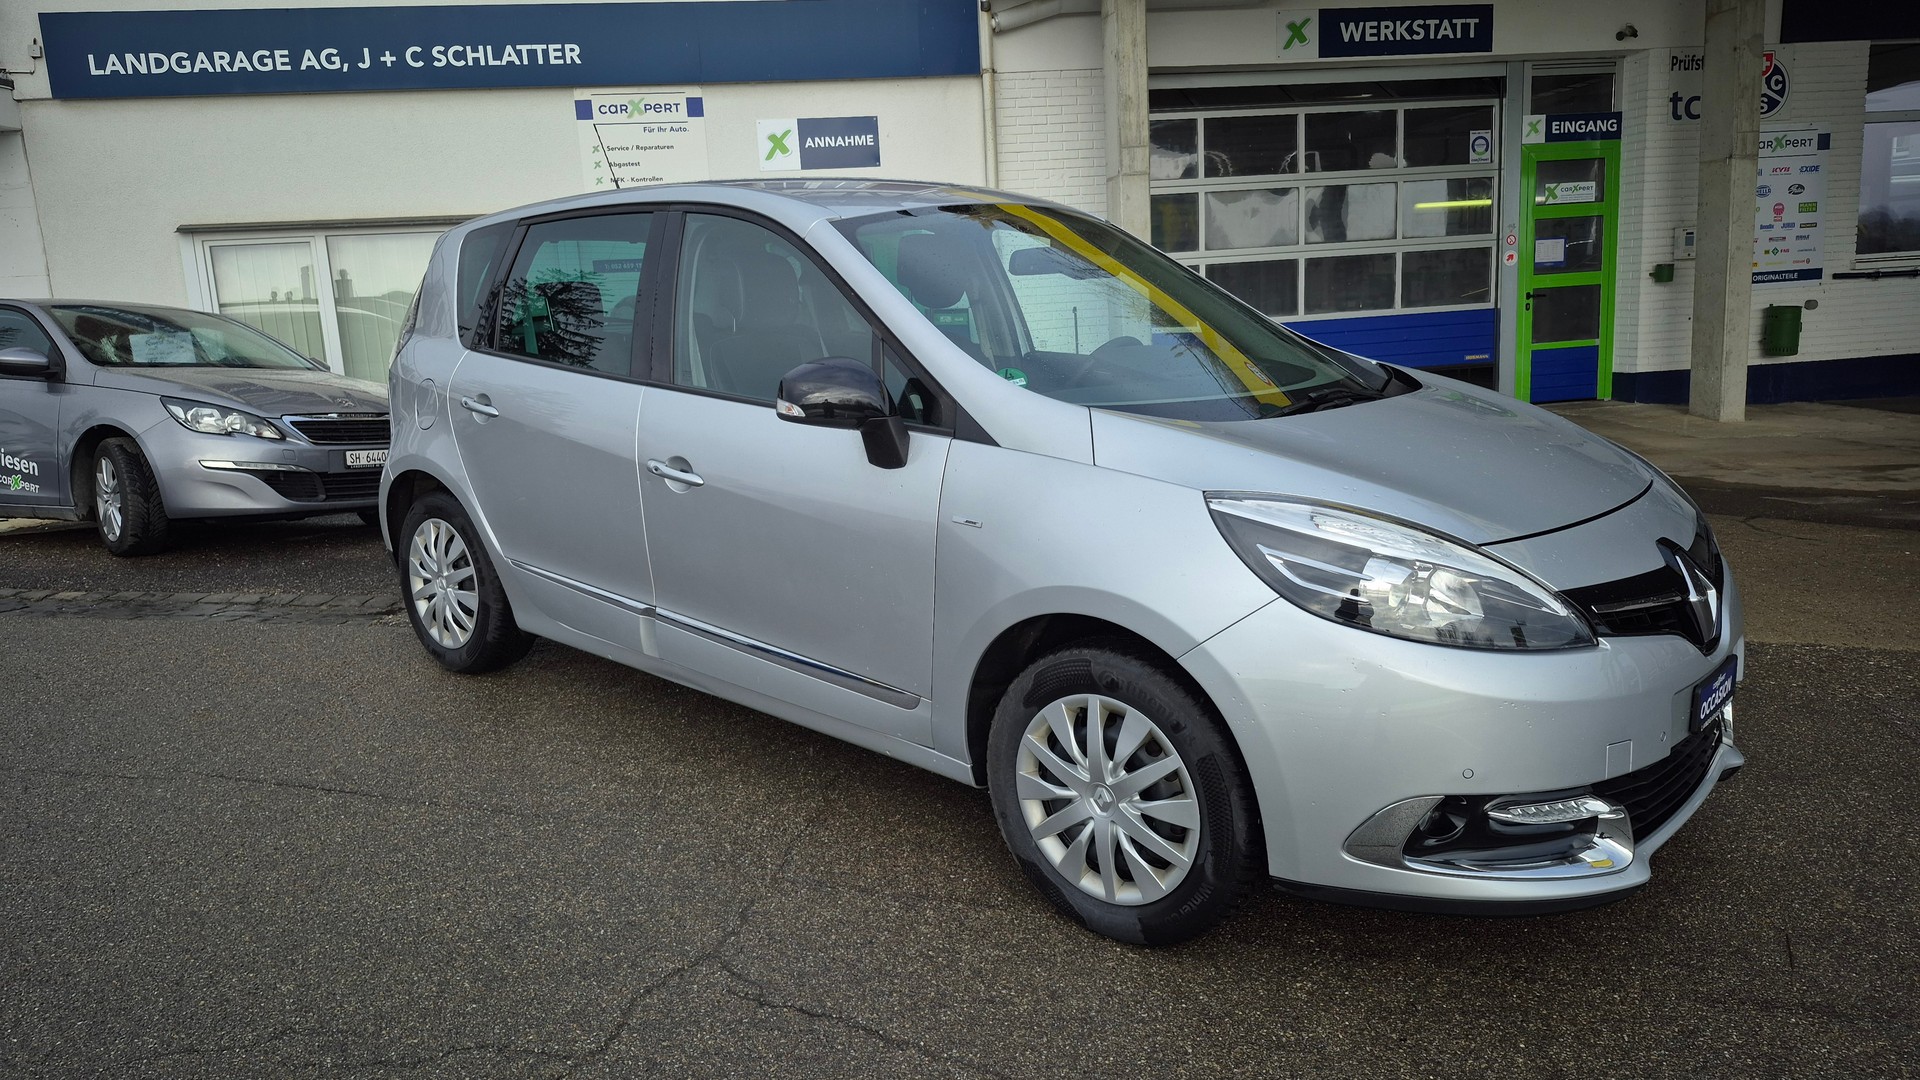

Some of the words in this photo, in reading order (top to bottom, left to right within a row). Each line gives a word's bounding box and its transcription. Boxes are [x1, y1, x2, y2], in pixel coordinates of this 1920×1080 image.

[1340, 18, 1479, 42] WERKSTATT
[88, 49, 291, 76] LANDGARAGE
[301, 49, 348, 72] AG,
[358, 51, 370, 70] J
[380, 52, 393, 67] +
[406, 46, 425, 68] C
[432, 44, 581, 67] SCHLATTER
[669, 125, 690, 133] Auto.
[1552, 119, 1618, 134] EINGANG
[636, 144, 675, 153] Reparaturen
[805, 134, 875, 149] ANNAHME
[609, 161, 641, 169] Abgastest
[1752, 272, 1798, 282] ORIGINALTEILE
[0, 448, 39, 476] iesen
[349, 452, 361, 464] SH
[366, 451, 387, 463] 6440
[1700, 675, 1733, 720] OCCASION
